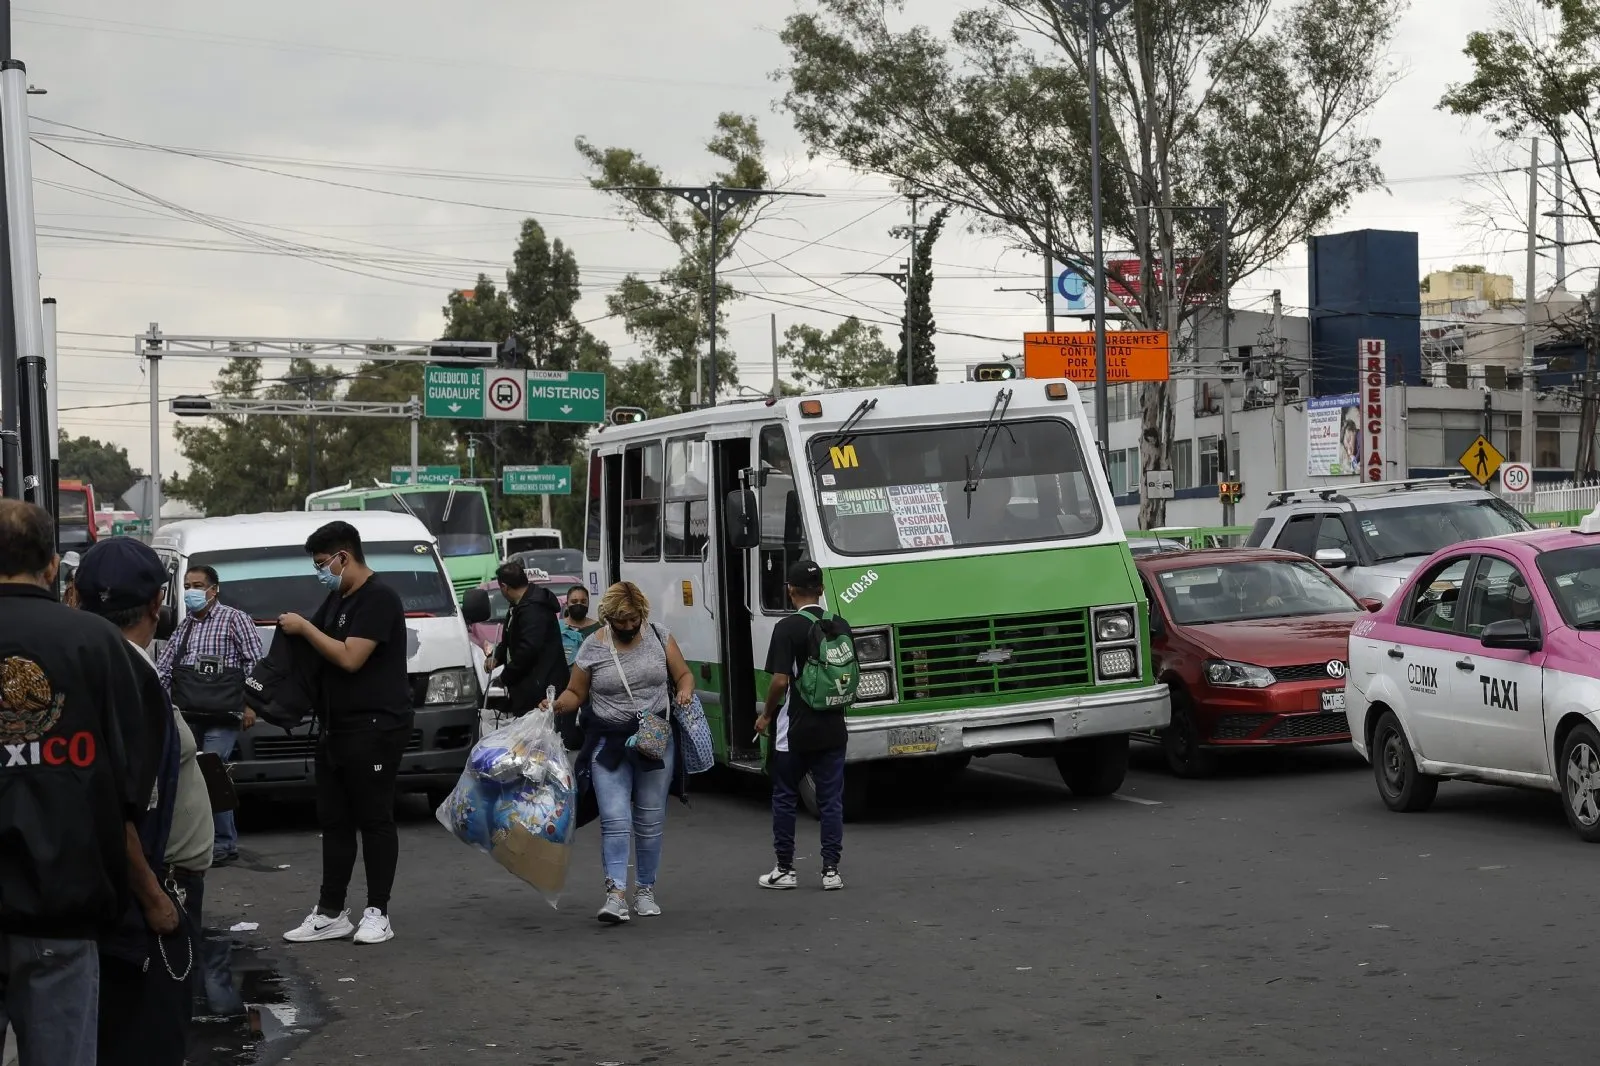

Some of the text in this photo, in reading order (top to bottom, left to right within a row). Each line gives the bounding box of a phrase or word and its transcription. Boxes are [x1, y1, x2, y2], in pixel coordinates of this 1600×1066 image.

[1035, 335, 1159, 345] LATERAL INURGENTES
[1067, 358, 1088, 367] POR
[429, 371, 480, 385] ACUEDUCTO DE
[532, 371, 562, 379] TICOMAN
[429, 387, 481, 400] GUADALUPE
[532, 386, 600, 399] MISTERIOS
[1367, 341, 1382, 481] URGENCIAS
[1323, 425, 1331, 438] 24
[829, 445, 859, 469] M
[1510, 471, 1523, 482] 50
[902, 493, 941, 505] GUADALUPE
[904, 503, 942, 515] WALMART
[908, 514, 946, 525] SORIANA
[899, 524, 949, 536] FERROPLAZA
[1407, 663, 1438, 688] CDMX
[825, 693, 854, 706] VERDE
[1479, 674, 1519, 712] TAXI
[0, 731, 96, 768] XICO
